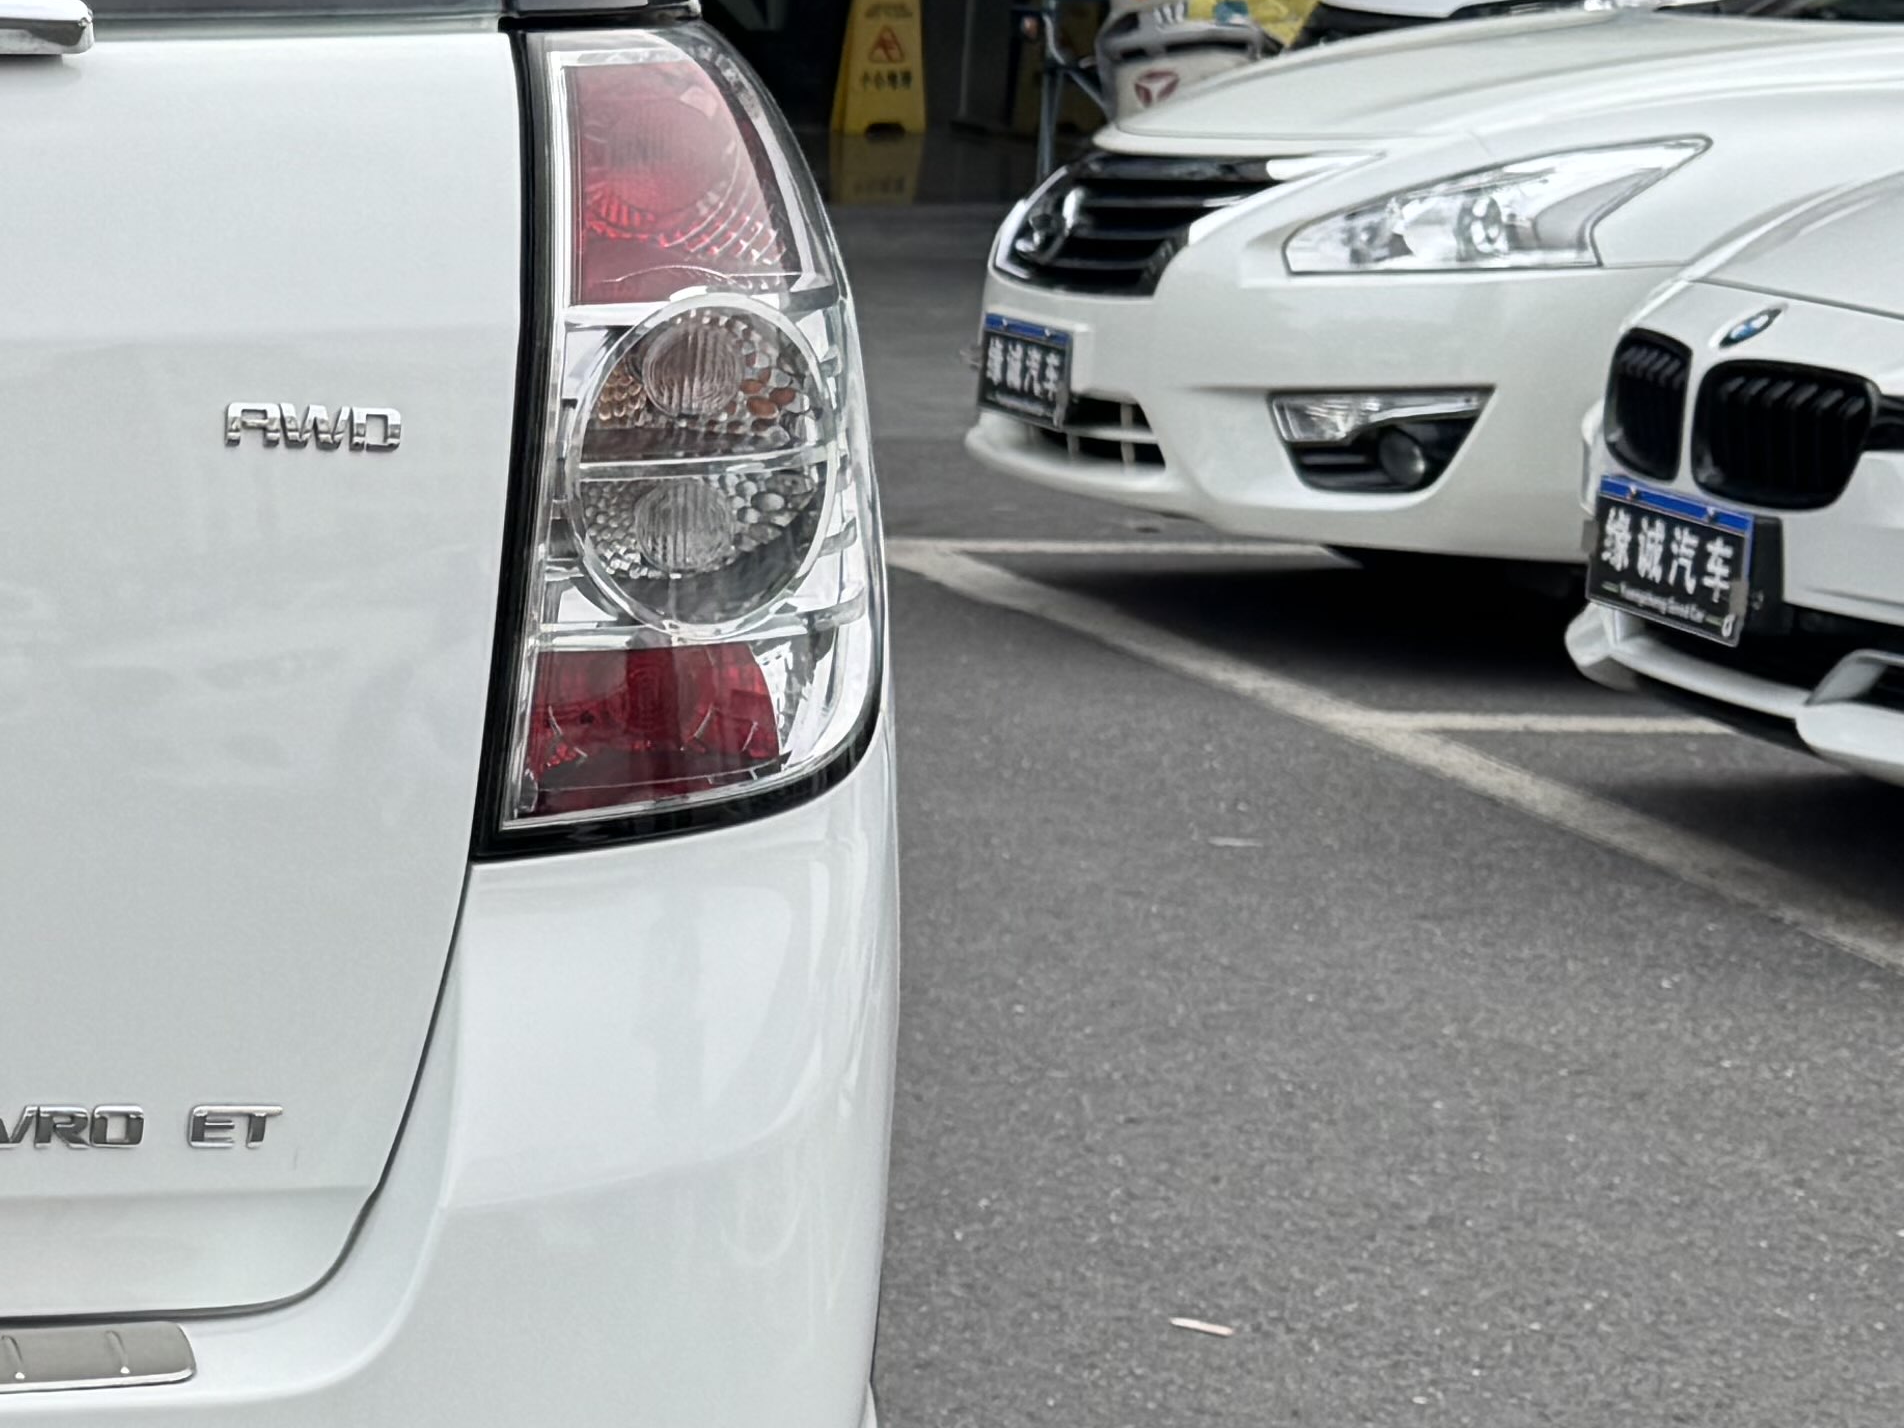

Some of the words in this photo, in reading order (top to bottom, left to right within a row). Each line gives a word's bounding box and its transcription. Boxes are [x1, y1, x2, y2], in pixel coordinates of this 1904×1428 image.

[225, 401, 402, 452] AWD
[1601, 506, 1735, 604] 缘诚汽车
[185, 1103, 285, 1150] ET
